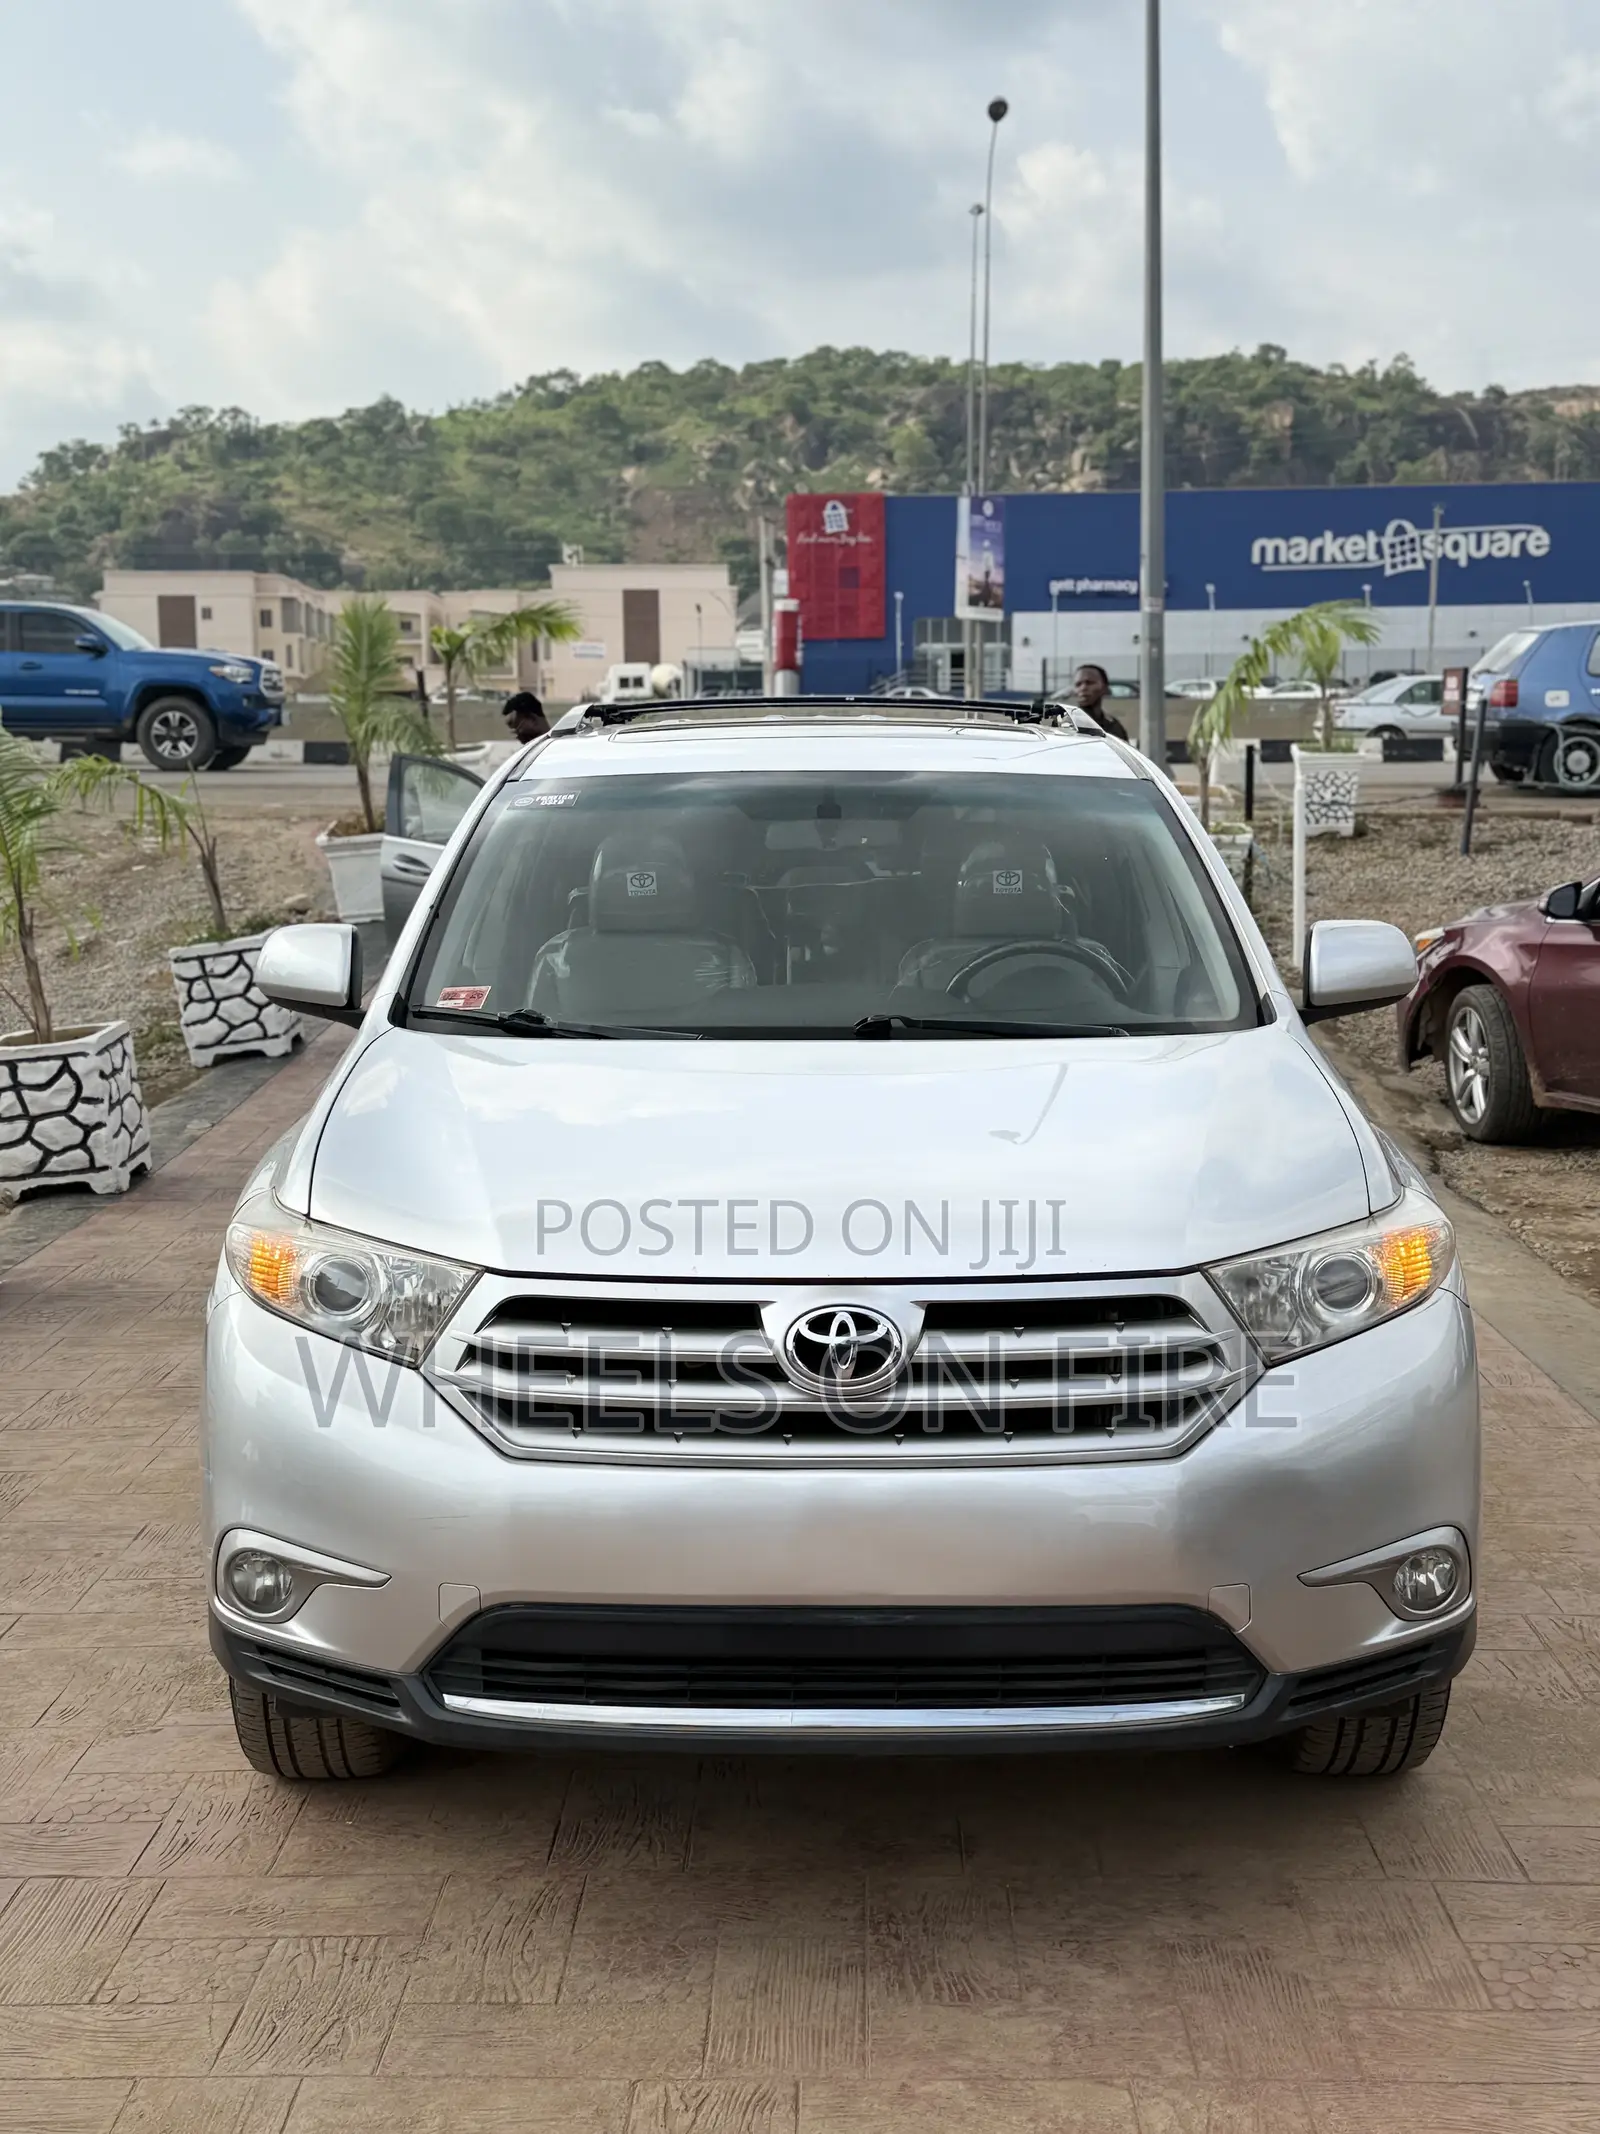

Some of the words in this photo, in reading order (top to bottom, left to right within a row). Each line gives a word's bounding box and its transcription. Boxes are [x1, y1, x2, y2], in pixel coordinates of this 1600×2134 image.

[1251, 529, 1383, 565] market
[1422, 527, 1551, 568] square
[1076, 577, 1138, 595] pharmacy
